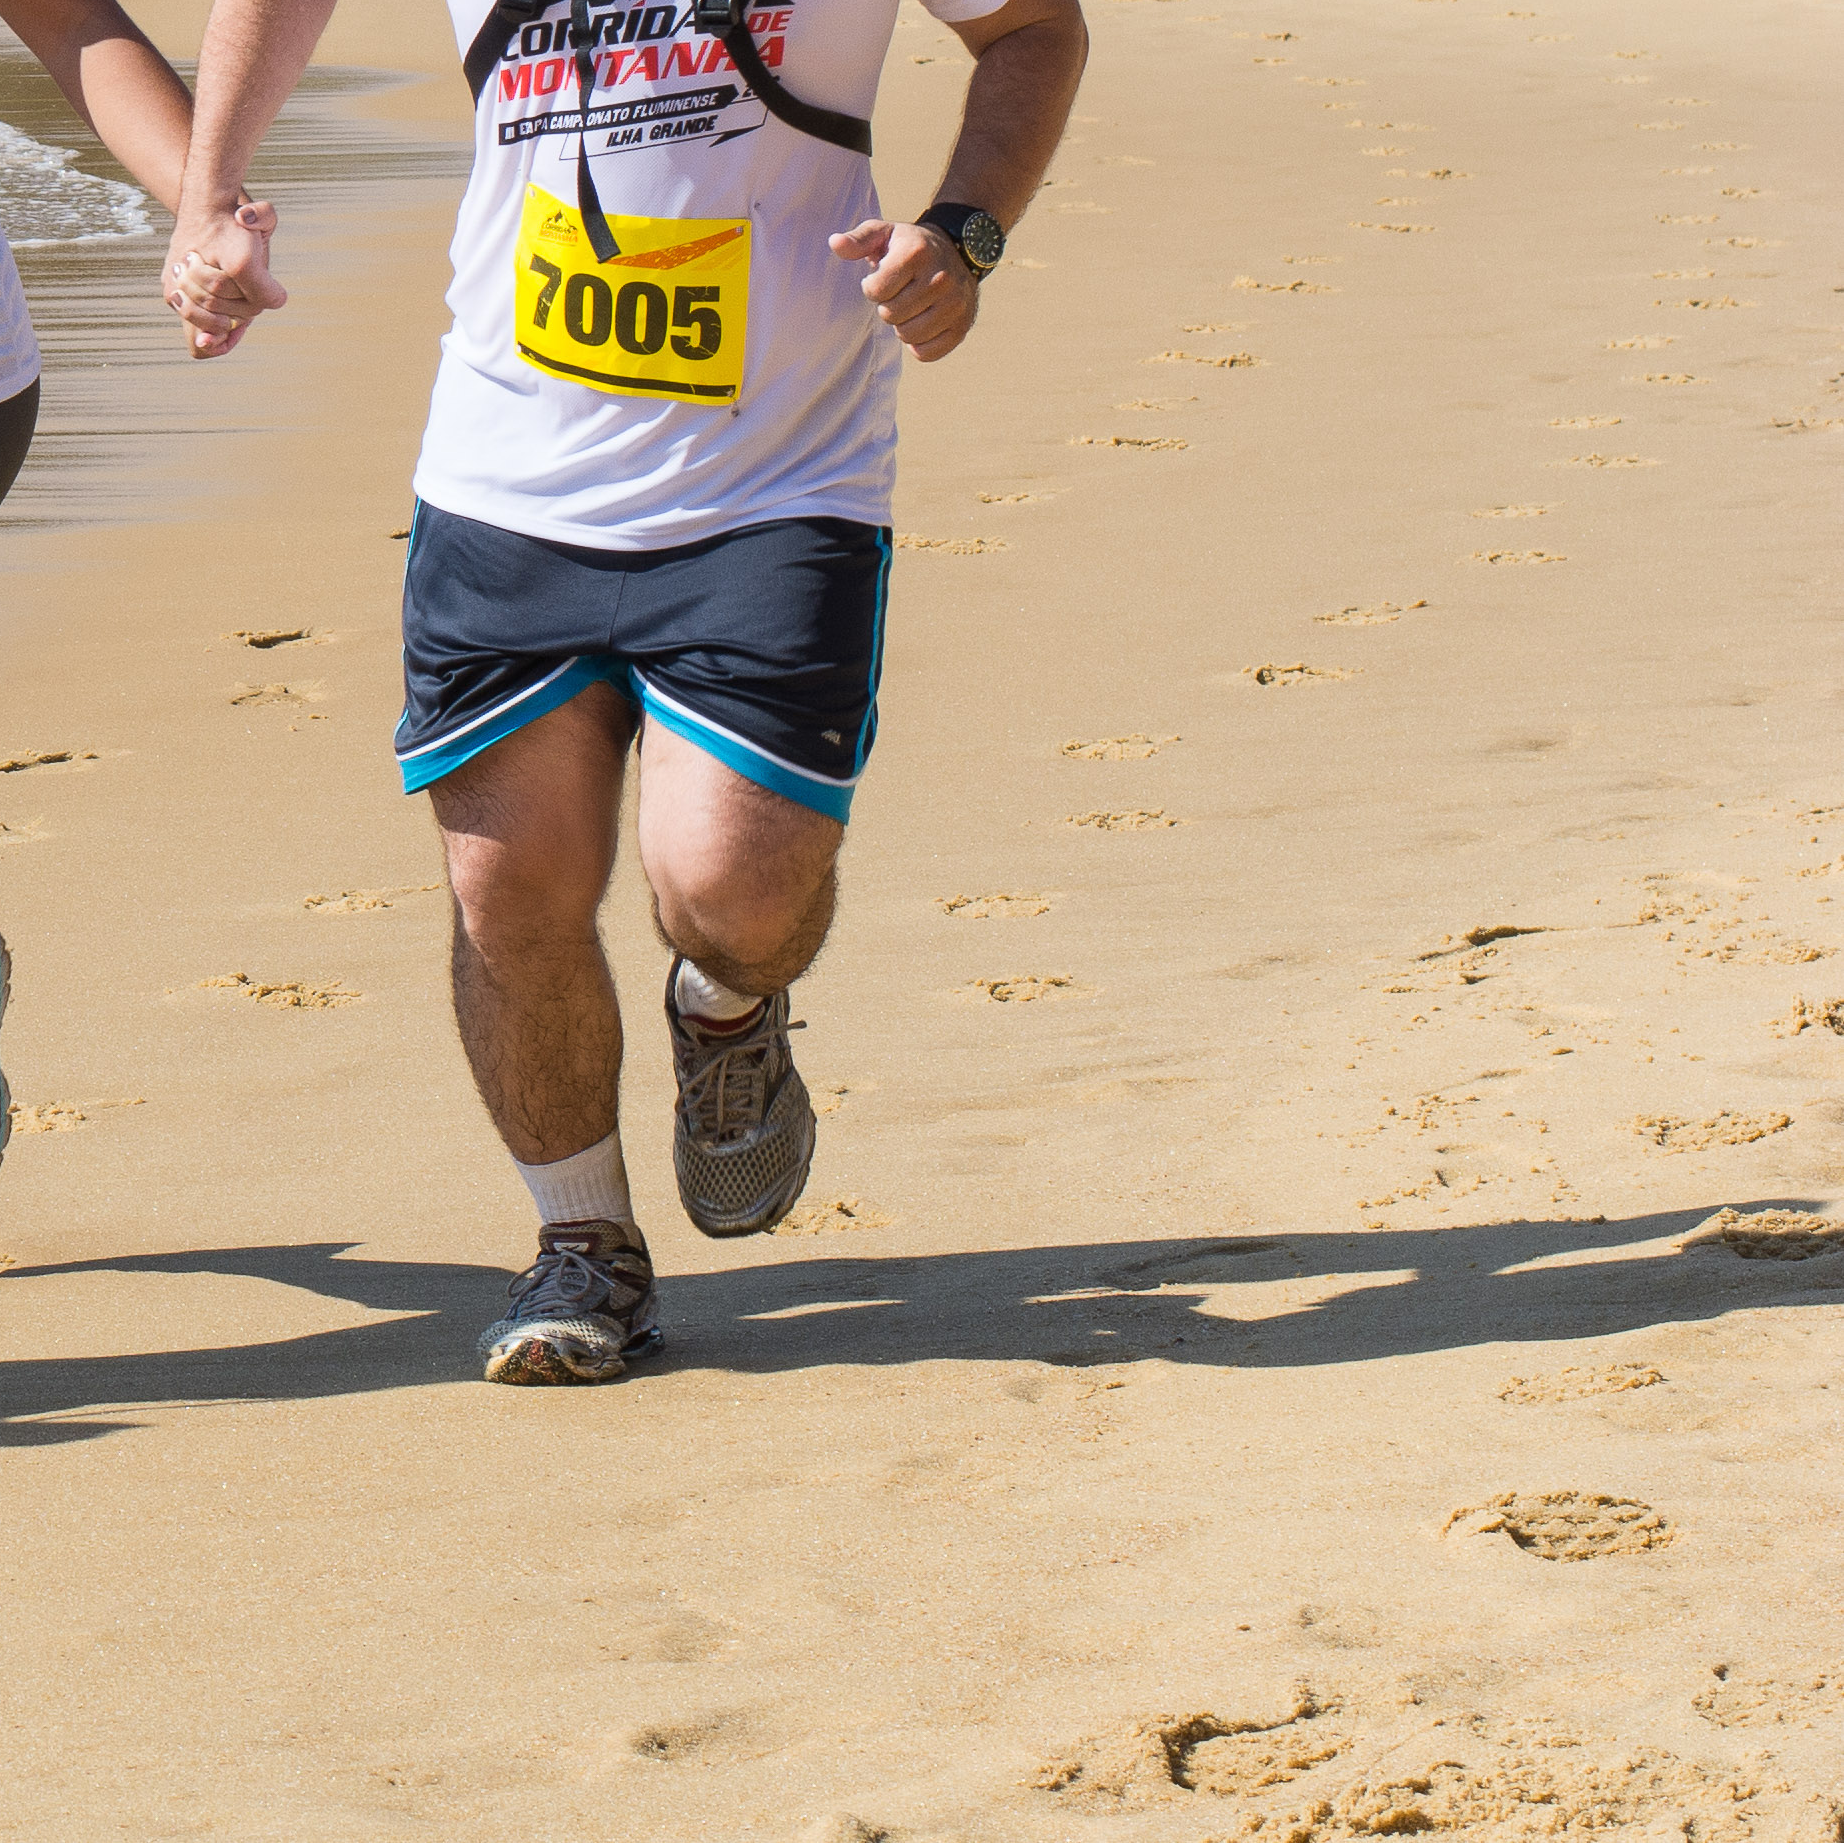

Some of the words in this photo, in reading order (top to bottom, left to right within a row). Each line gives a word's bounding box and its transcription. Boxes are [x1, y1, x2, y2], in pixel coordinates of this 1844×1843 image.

[746, 10, 794, 34] DE
[550, 107, 631, 130] CAMPONATO
[632, 92, 720, 120] FLUMINENSE
[606, 127, 643, 148] ILHA
[649, 114, 719, 141] GRANDE
[529, 253, 723, 361] 7005
